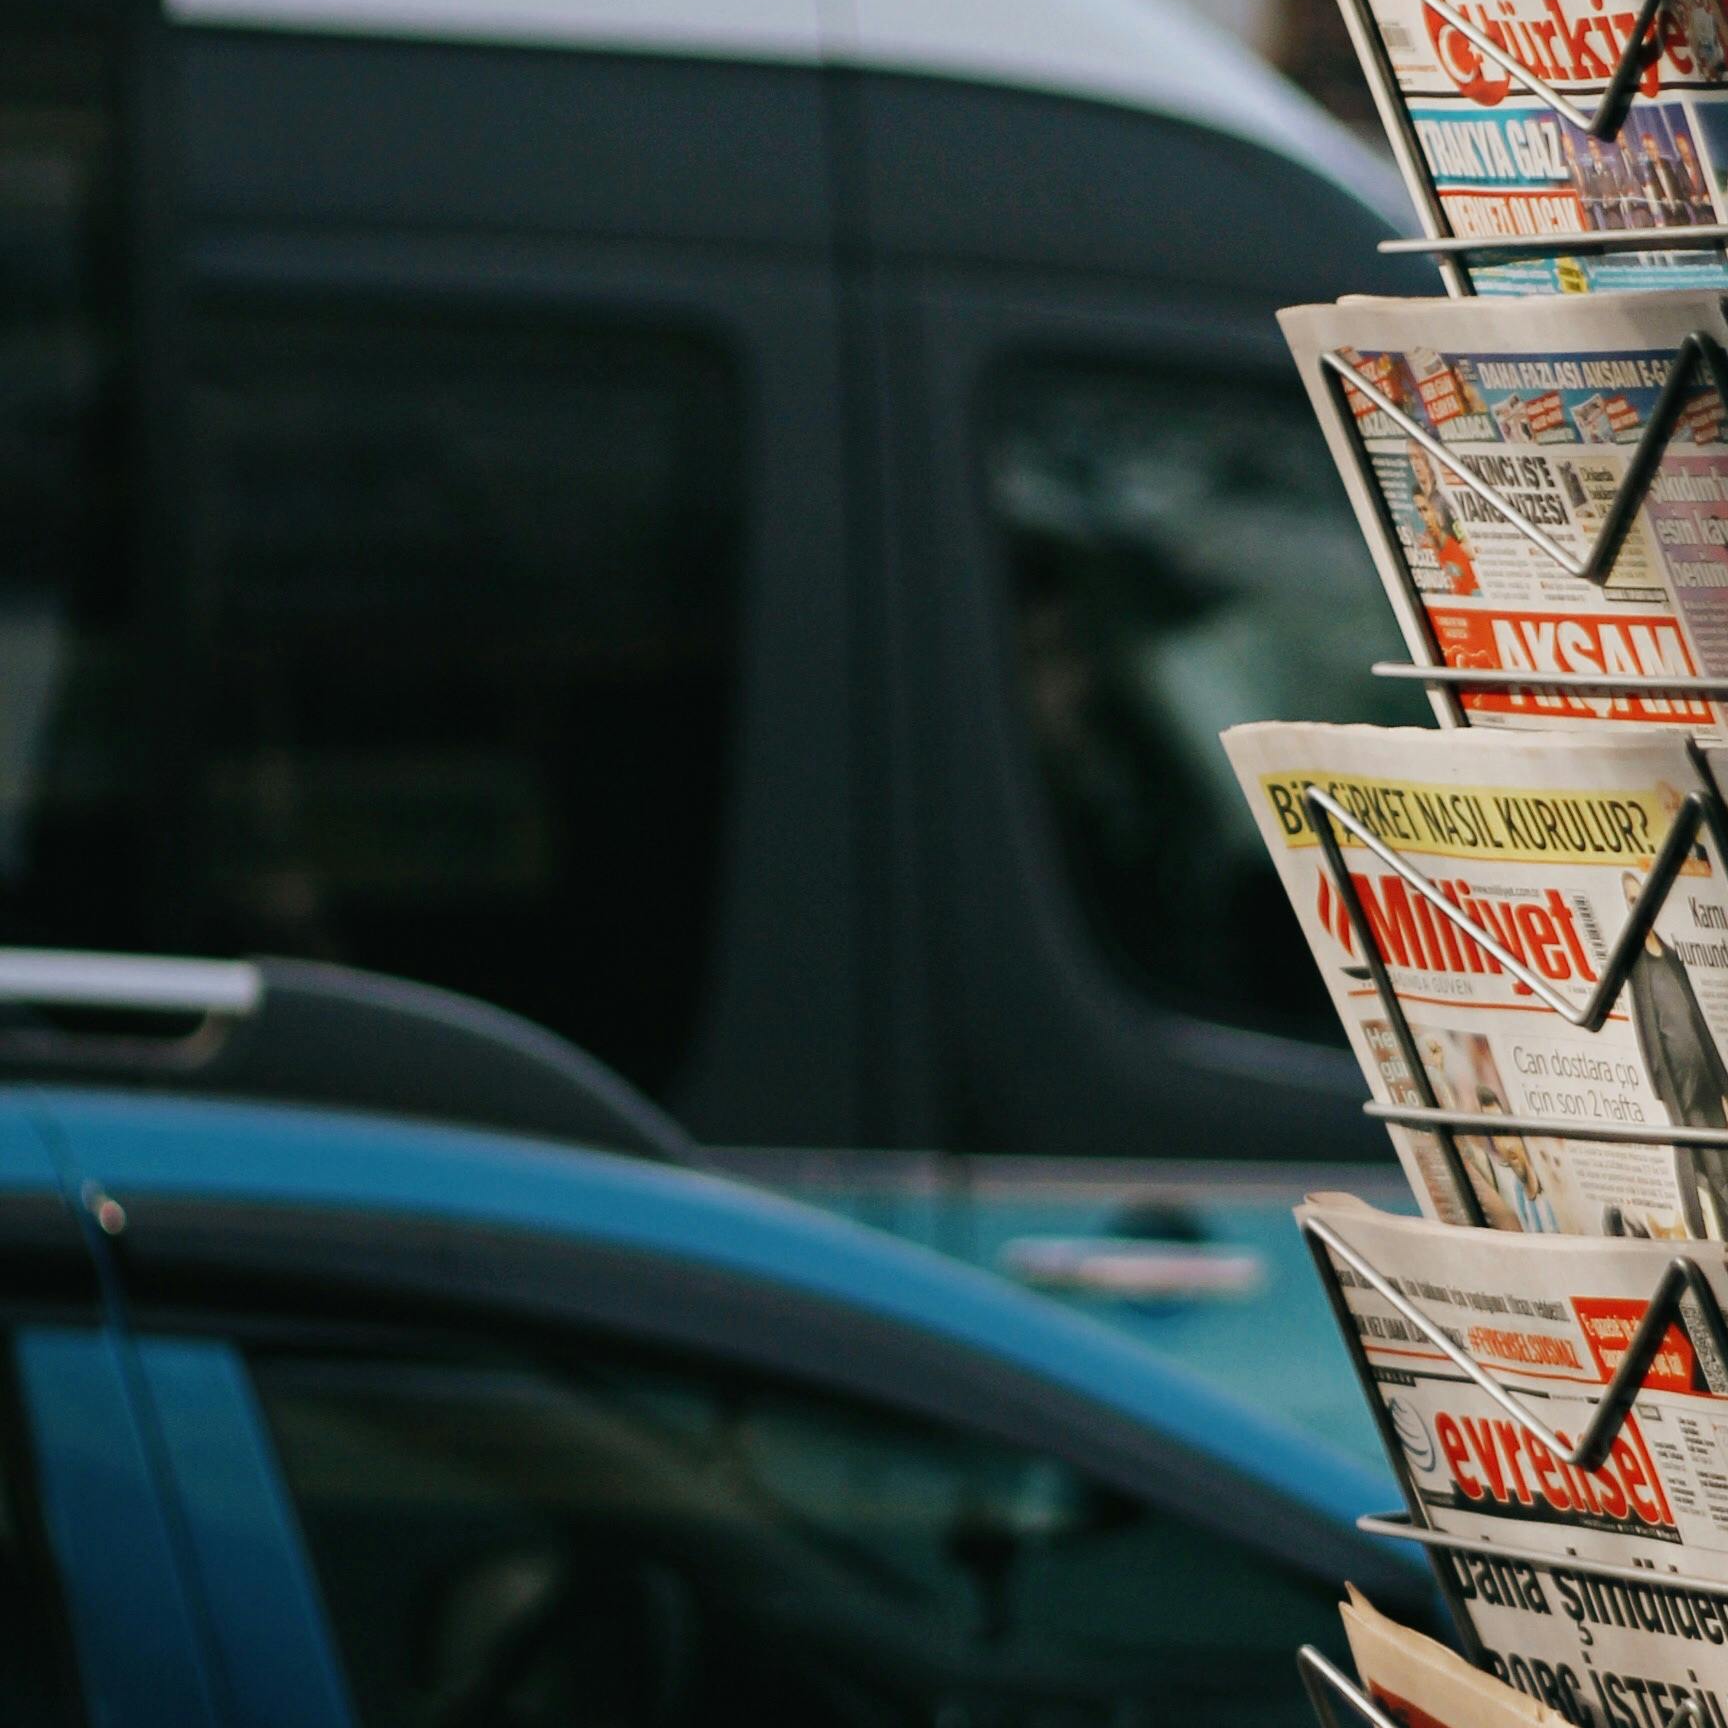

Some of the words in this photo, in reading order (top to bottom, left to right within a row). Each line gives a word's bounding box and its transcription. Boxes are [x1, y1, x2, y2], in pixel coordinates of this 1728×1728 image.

[1413, 119, 1518, 180] TRAKYA
[1505, 117, 1569, 181] GAZ
[1477, 361, 1521, 390] DAHA
[1519, 361, 1582, 390] FAZLASI
[1581, 359, 1643, 391] AKŞAM
[1490, 618, 1709, 718] AKŞAM
[1327, 780, 1422, 843] ŞİRKET
[1413, 790, 1504, 850] NASIL
[1493, 796, 1657, 856] KURULUR?
[1348, 872, 1598, 996] Milliyet
[1511, 1044, 1549, 1076] Can
[1548, 1050, 1616, 1085] dostlara
[1613, 1062, 1640, 1093] çip
[1521, 1083, 1557, 1114] için
[1556, 1090, 1588, 1116] son
[1587, 1089, 1602, 1119] 2
[1600, 1092, 1646, 1124] hafta
[1434, 1409, 1677, 1527] evrensel
